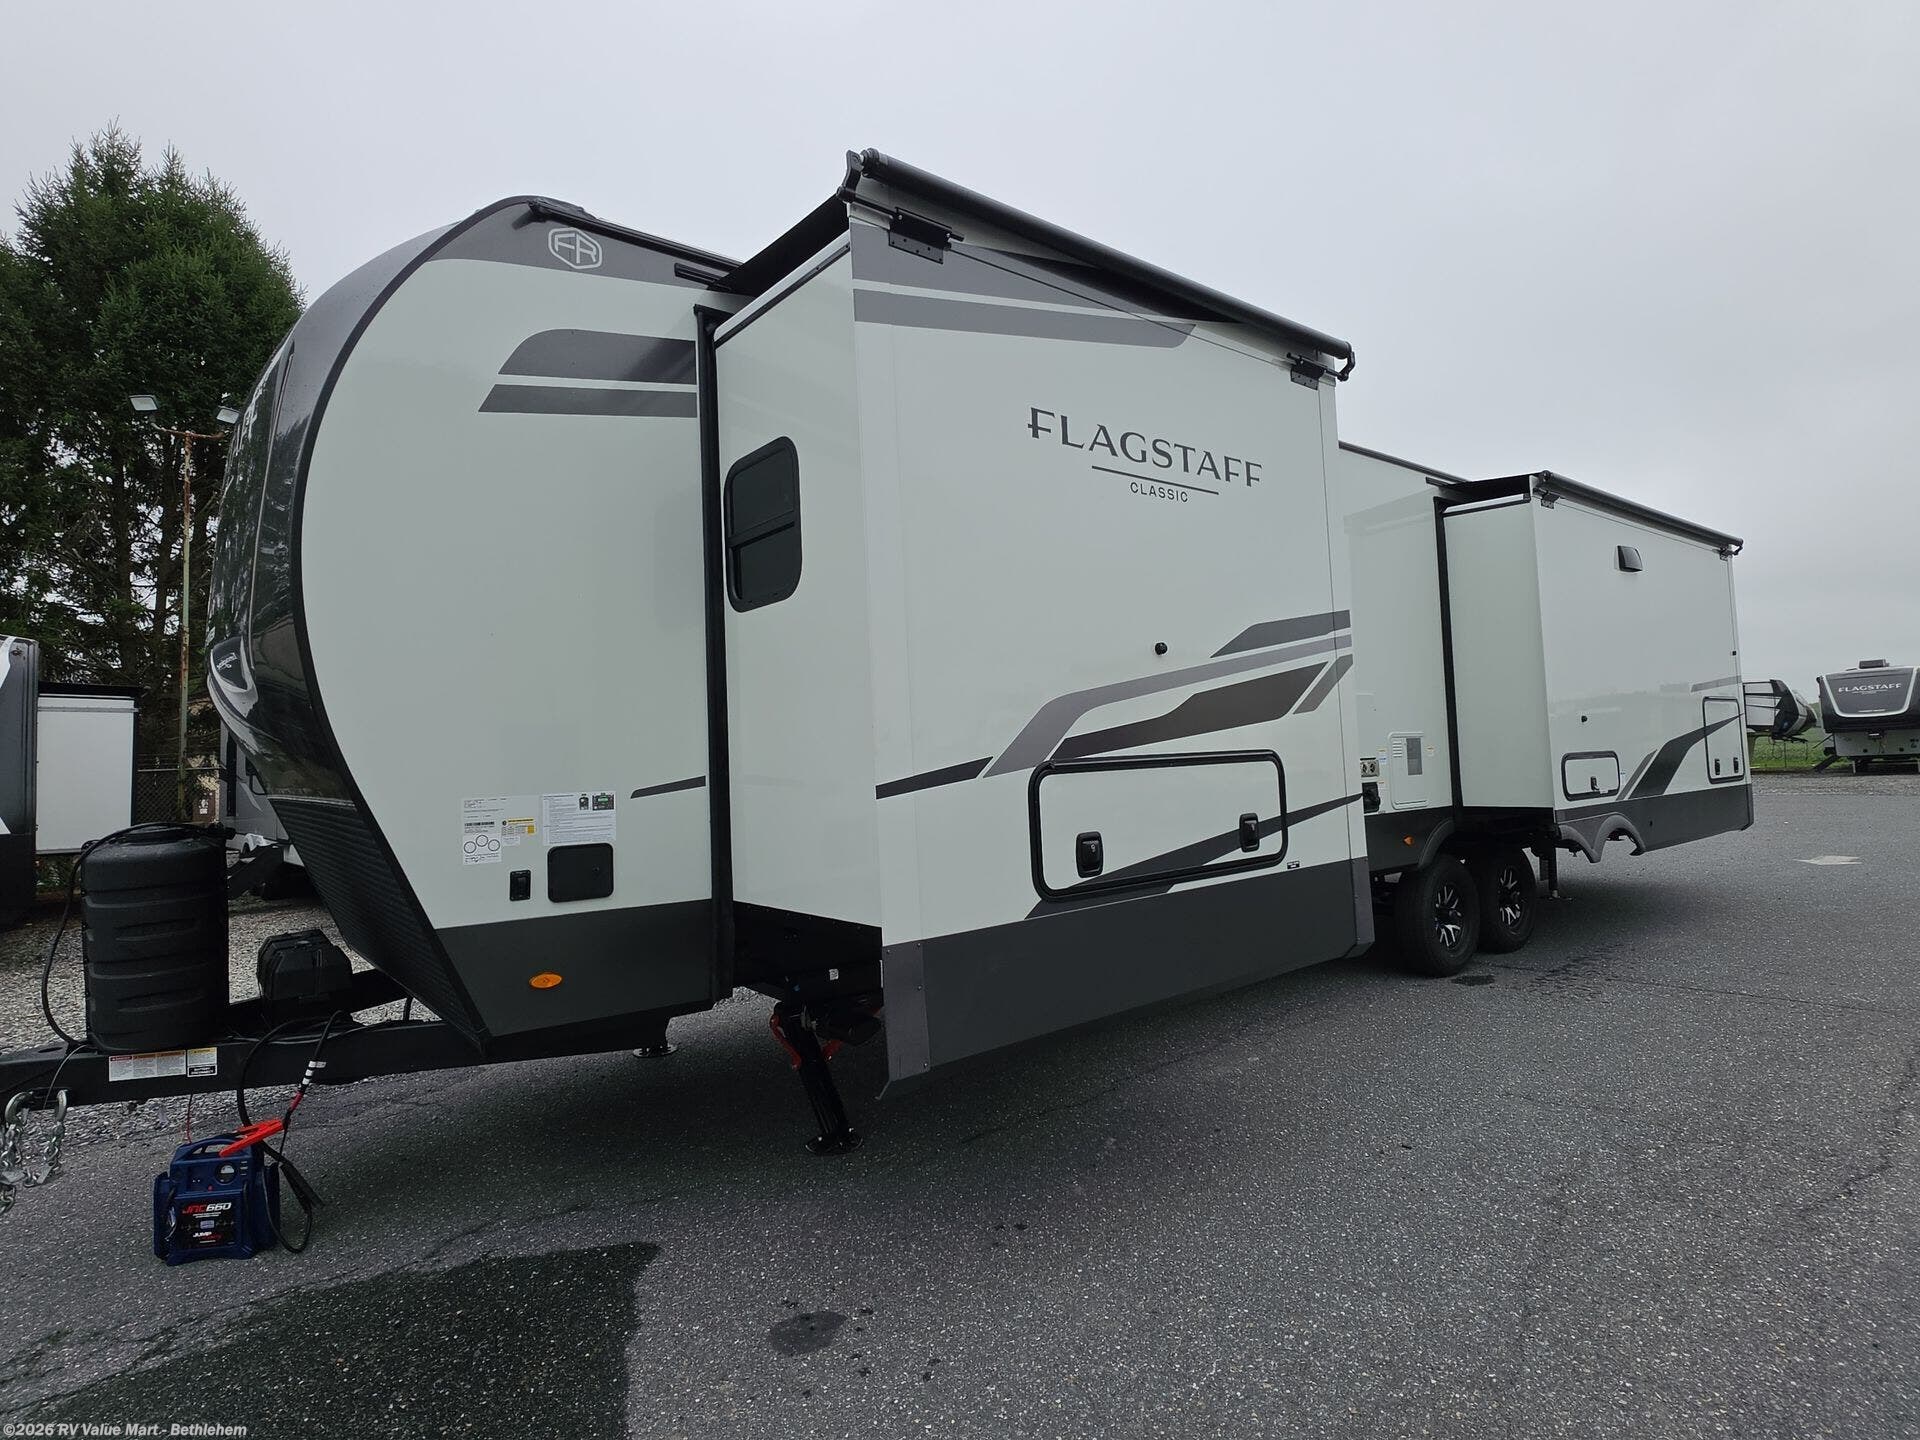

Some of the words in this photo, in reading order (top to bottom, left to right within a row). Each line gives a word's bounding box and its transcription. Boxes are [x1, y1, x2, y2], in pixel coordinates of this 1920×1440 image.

[1027, 406, 1262, 488] FLAGSTAFF
[1129, 481, 1189, 503] CLASSIC
[1838, 683, 1901, 692] FLAGSTAFF
